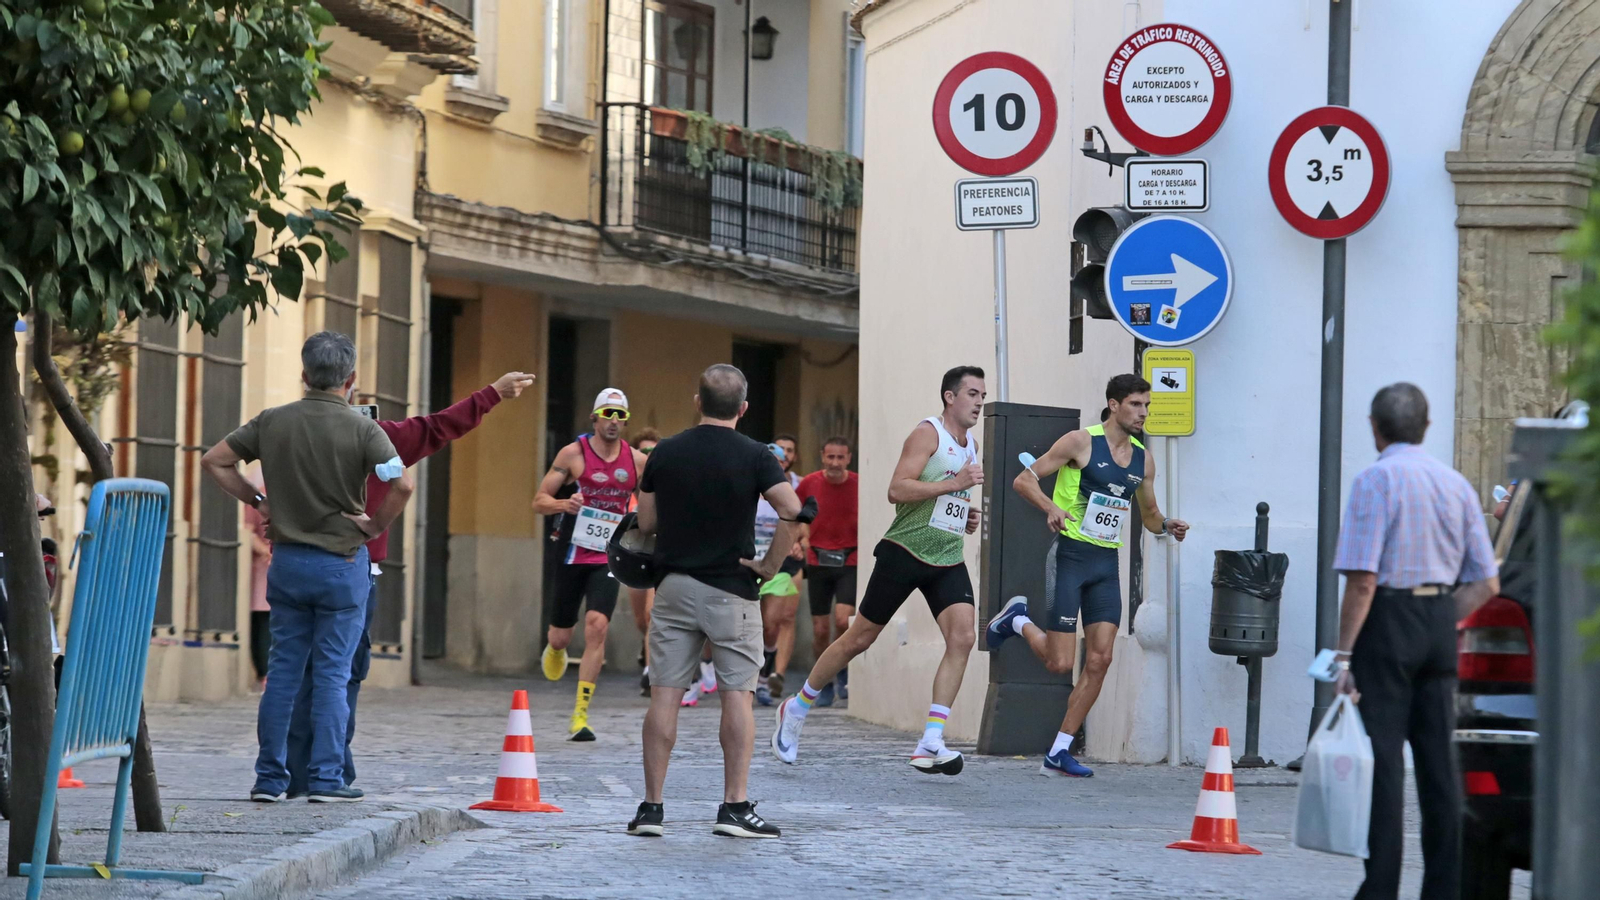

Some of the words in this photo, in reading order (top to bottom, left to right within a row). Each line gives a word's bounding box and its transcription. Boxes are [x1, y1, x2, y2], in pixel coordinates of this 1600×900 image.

[1105, 58, 1125, 85] ÁREA
[1119, 43, 1135, 60] DE
[1131, 27, 1173, 49] TRÁFICO
[1175, 28, 1226, 78] RESTRINGIDO
[1147, 66, 1185, 75] EXCEPTO
[1132, 80, 1191, 90] AUTORIZADOS
[1194, 80, 1200, 89] Y
[1125, 94, 1154, 104] CARGA
[1156, 94, 1162, 104] Y
[1164, 94, 1209, 104] DESCARGA
[963, 92, 1026, 132] 10
[1306, 159, 1343, 185] 3,5
[1344, 148, 1361, 160] m
[1138, 180, 1159, 188] CARGA
[1160, 180, 1164, 188] Y
[1165, 179, 1197, 187] DESCARGA
[963, 186, 1031, 199] PREFERENCIA
[972, 205, 1023, 217] PEATONES
[945, 502, 965, 520] 830
[1095, 511, 1119, 528] 665
[586, 524, 610, 539] 538
